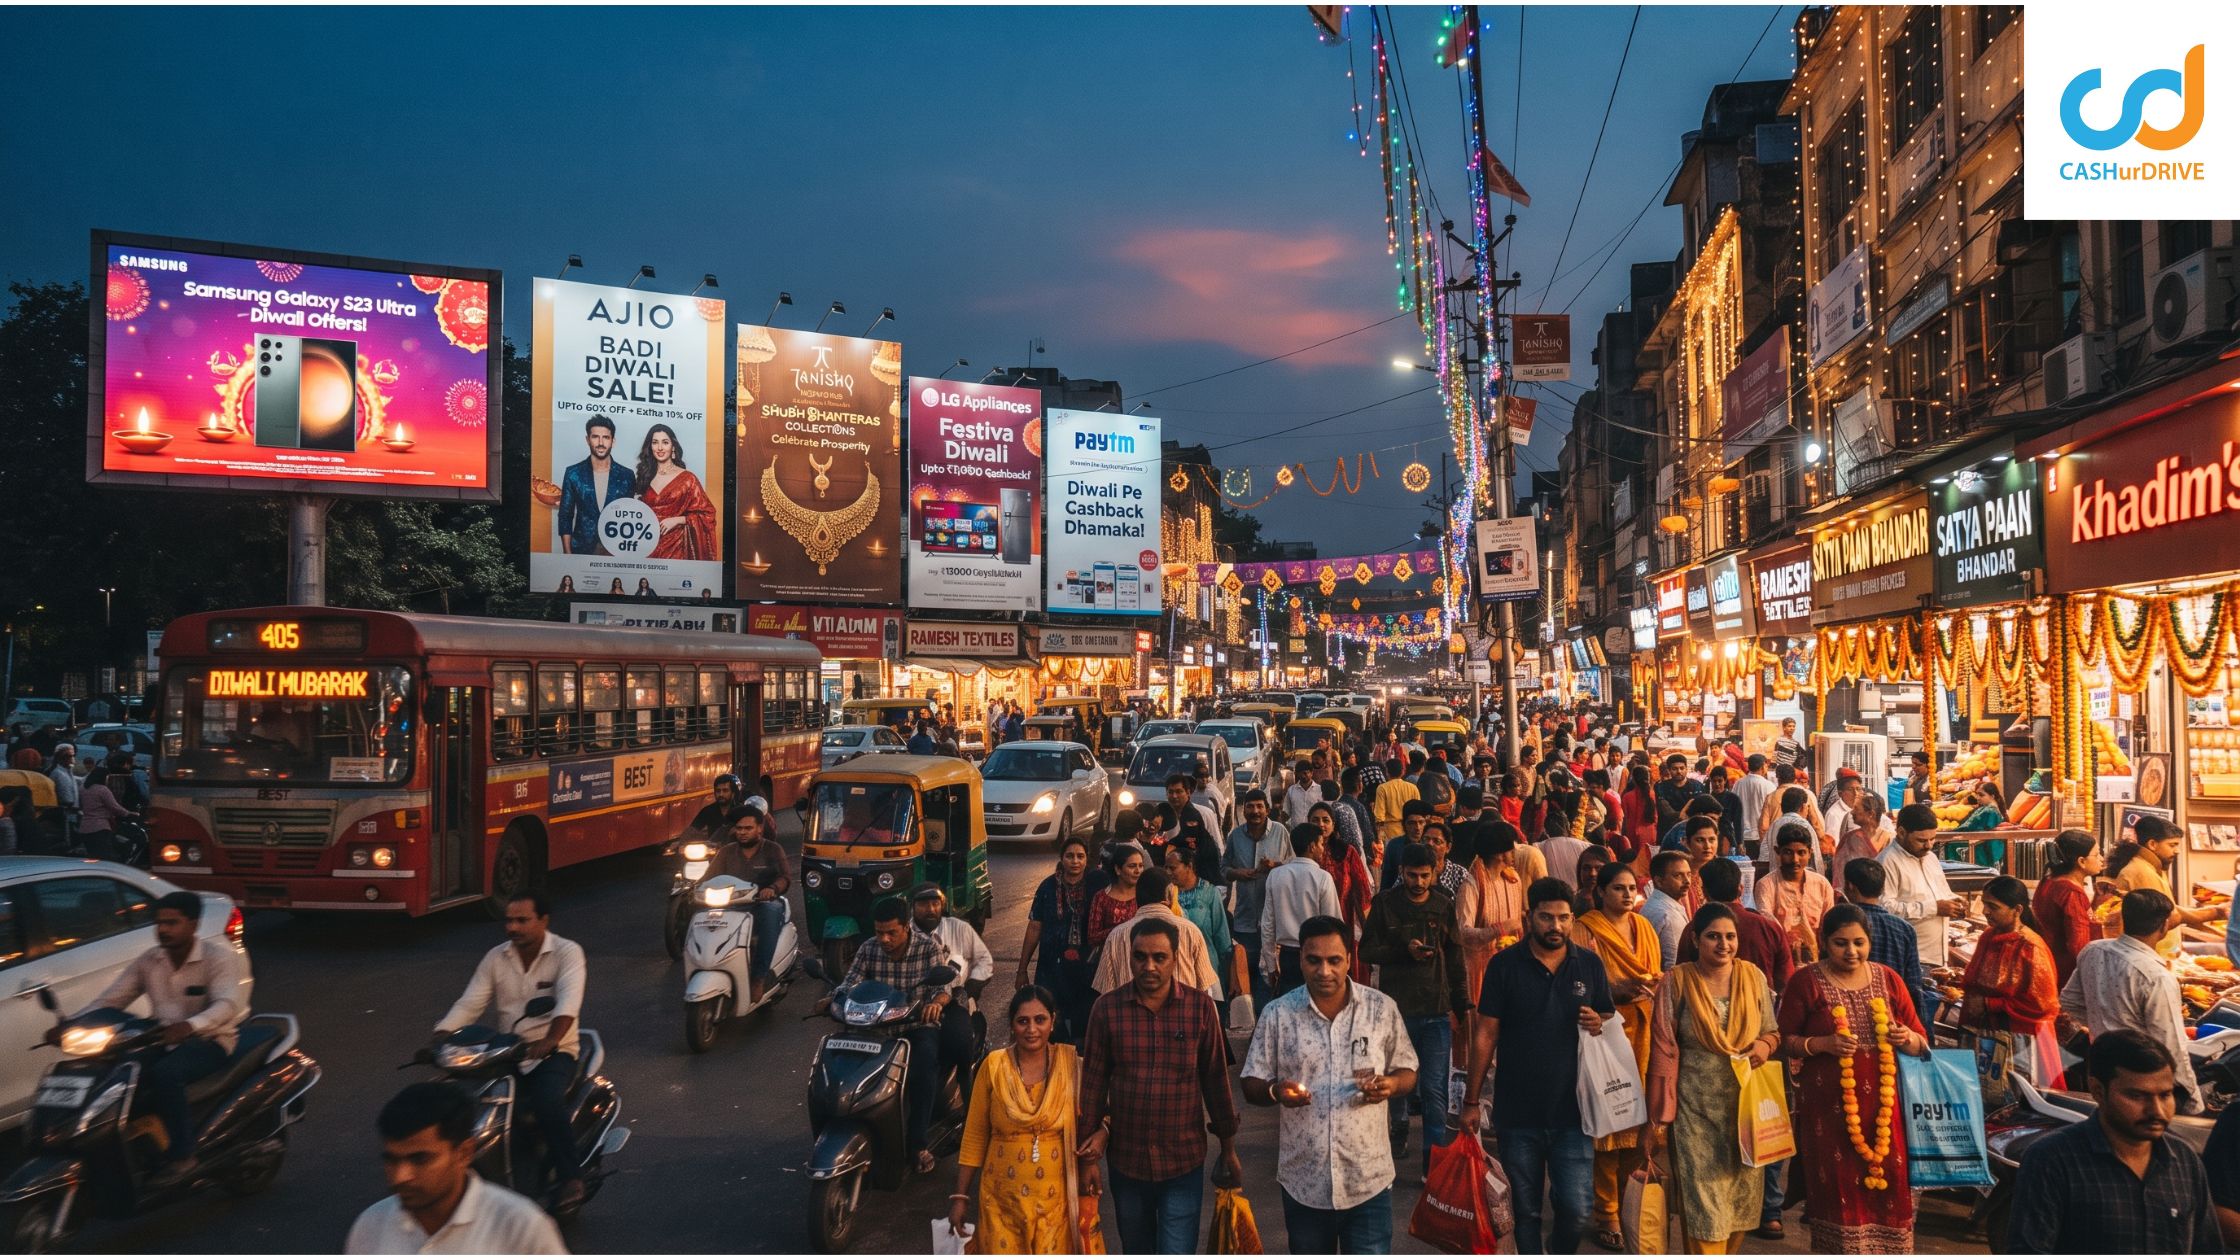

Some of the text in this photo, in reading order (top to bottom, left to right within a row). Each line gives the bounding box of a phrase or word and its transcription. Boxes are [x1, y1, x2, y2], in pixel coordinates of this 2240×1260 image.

[119, 254, 188, 273] SAMSUNG
[183, 281, 416, 317] Samsung Galaxy S23 Ultra
[307, 312, 367, 332] Offers!
[587, 297, 674, 330] AJIO
[600, 335, 661, 359] BADI
[585, 355, 675, 381] DIWALI
[586, 376, 674, 405] SALE!
[609, 405, 627, 415] OFF
[665, 410, 683, 420] 10%
[686, 412, 703, 421] OFF
[941, 392, 1032, 414] LG Appliances
[940, 417, 1014, 443] Festiva
[821, 438, 870, 455] Prosperity
[945, 441, 1008, 463] Diwali
[920, 463, 945, 476] Upto
[1068, 480, 1142, 500] Diwali Pe
[615, 510, 643, 519] UPTO
[1065, 500, 1144, 519] Cashback
[604, 521, 653, 541] 60%
[1065, 519, 1145, 538] Dhamaka!
[1937, 489, 2032, 557] SATYA PAAN
[1842, 527, 1870, 574] PAAN
[1871, 508, 1929, 567] BHANDAR
[1957, 548, 2016, 583] BHANDAR
[1760, 560, 1810, 600] RAMESH
[261, 623, 300, 649] 405
[911, 630, 1014, 647] RAMESH TEXTILES
[209, 671, 368, 697] DIWALI MUBARAK
[624, 765, 654, 789] BEST
[257, 788, 291, 800] BEST
